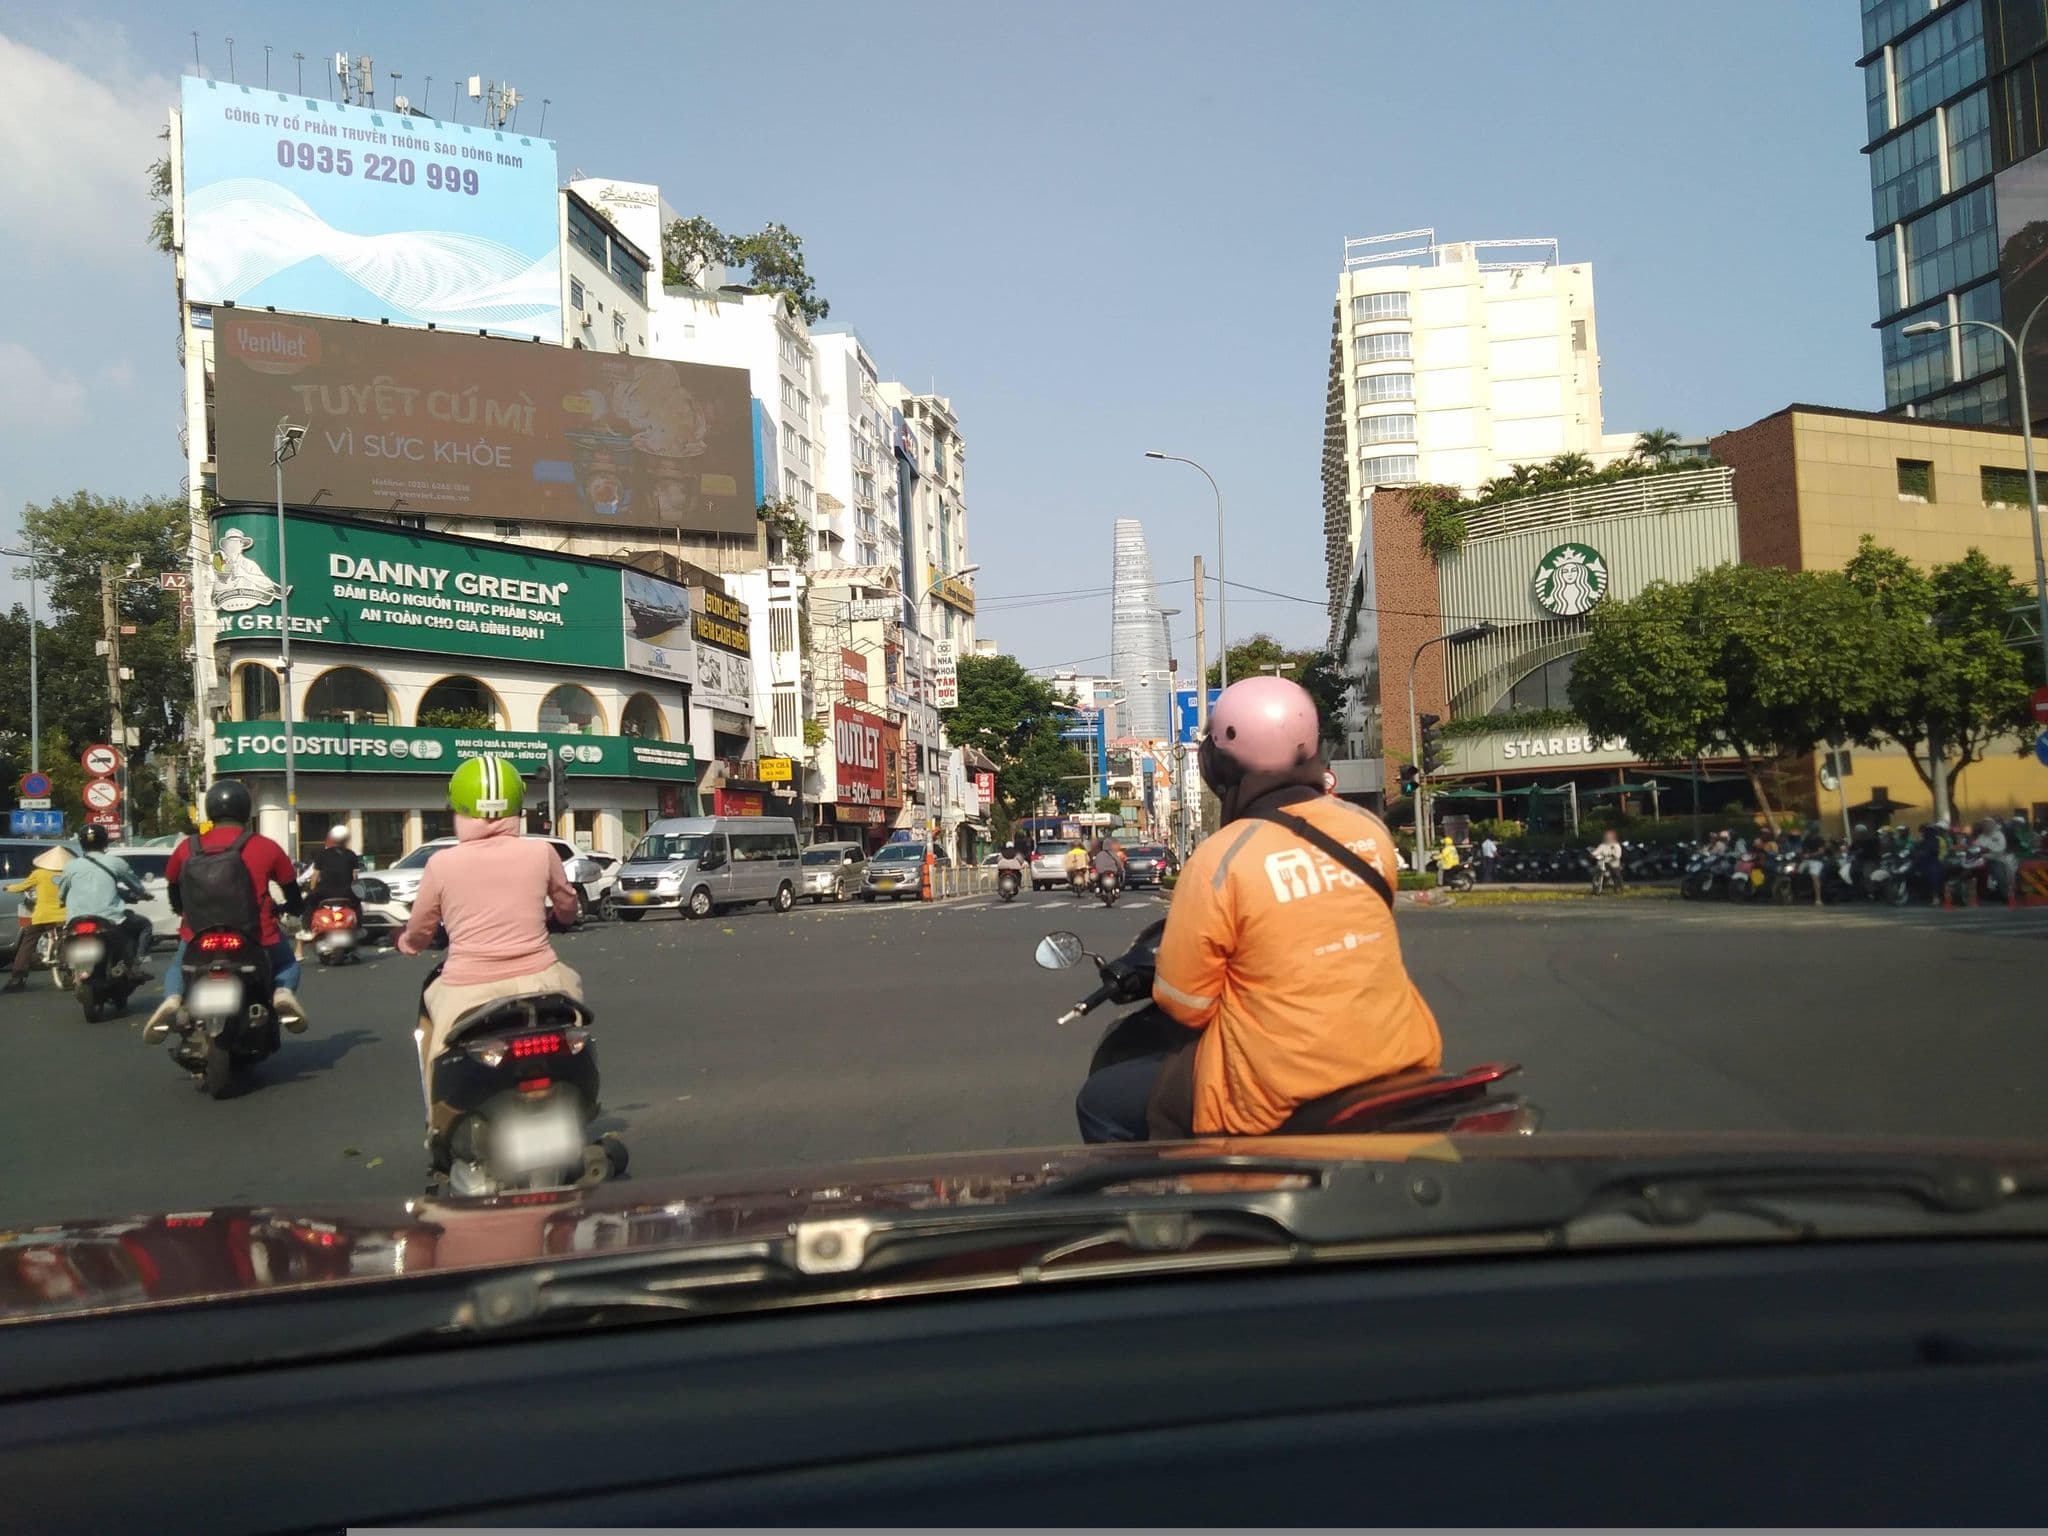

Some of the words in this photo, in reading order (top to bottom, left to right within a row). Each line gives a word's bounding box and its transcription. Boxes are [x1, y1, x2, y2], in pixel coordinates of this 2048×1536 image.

[225, 107, 260, 124] CÔNG
[265, 113, 279, 127] TY
[284, 114, 300, 131] CỔ
[392, 135, 430, 151] THÔNG
[434, 142, 457, 156] SAO
[497, 153, 523, 168] NAM
[277, 140, 353, 176] 0935
[364, 153, 416, 185] 220
[426, 163, 479, 195] 999
[291, 375, 421, 421] TUYỆT
[427, 385, 479, 425] CÚ
[485, 390, 537, 436] MÌ
[325, 426, 354, 456] VÌ
[364, 431, 426, 462] SỨC
[433, 438, 513, 468] KHỎE
[164, 575, 187, 588] A2
[329, 553, 450, 591] DANNY
[454, 572, 562, 606] GREEN
[333, 584, 367, 600] ĐẢM
[369, 588, 401, 604] BẢO
[403, 593, 452, 611] NGUỒN
[454, 600, 490, 617] THỰC
[491, 603, 526, 620] PHẨM
[528, 609, 564, 627] SẠCH,
[360, 608, 381, 621] AN
[384, 610, 422, 625] TOÀN
[424, 615, 454, 629] CHO
[455, 619, 479, 633] GIA
[480, 621, 510, 636] ĐÌNH
[512, 626, 538, 640] BẠN
[936, 667, 955, 675] KHOA
[937, 657, 953, 665] NHA
[936, 677, 955, 686] TÂM
[938, 686, 955, 698] ĐỨC
[238, 735, 388, 757] FOODSTUFFS
[836, 719, 880, 769] OUTLET
[1503, 735, 1629, 759] STARBUCK
[852, 781, 870, 804] 50%
